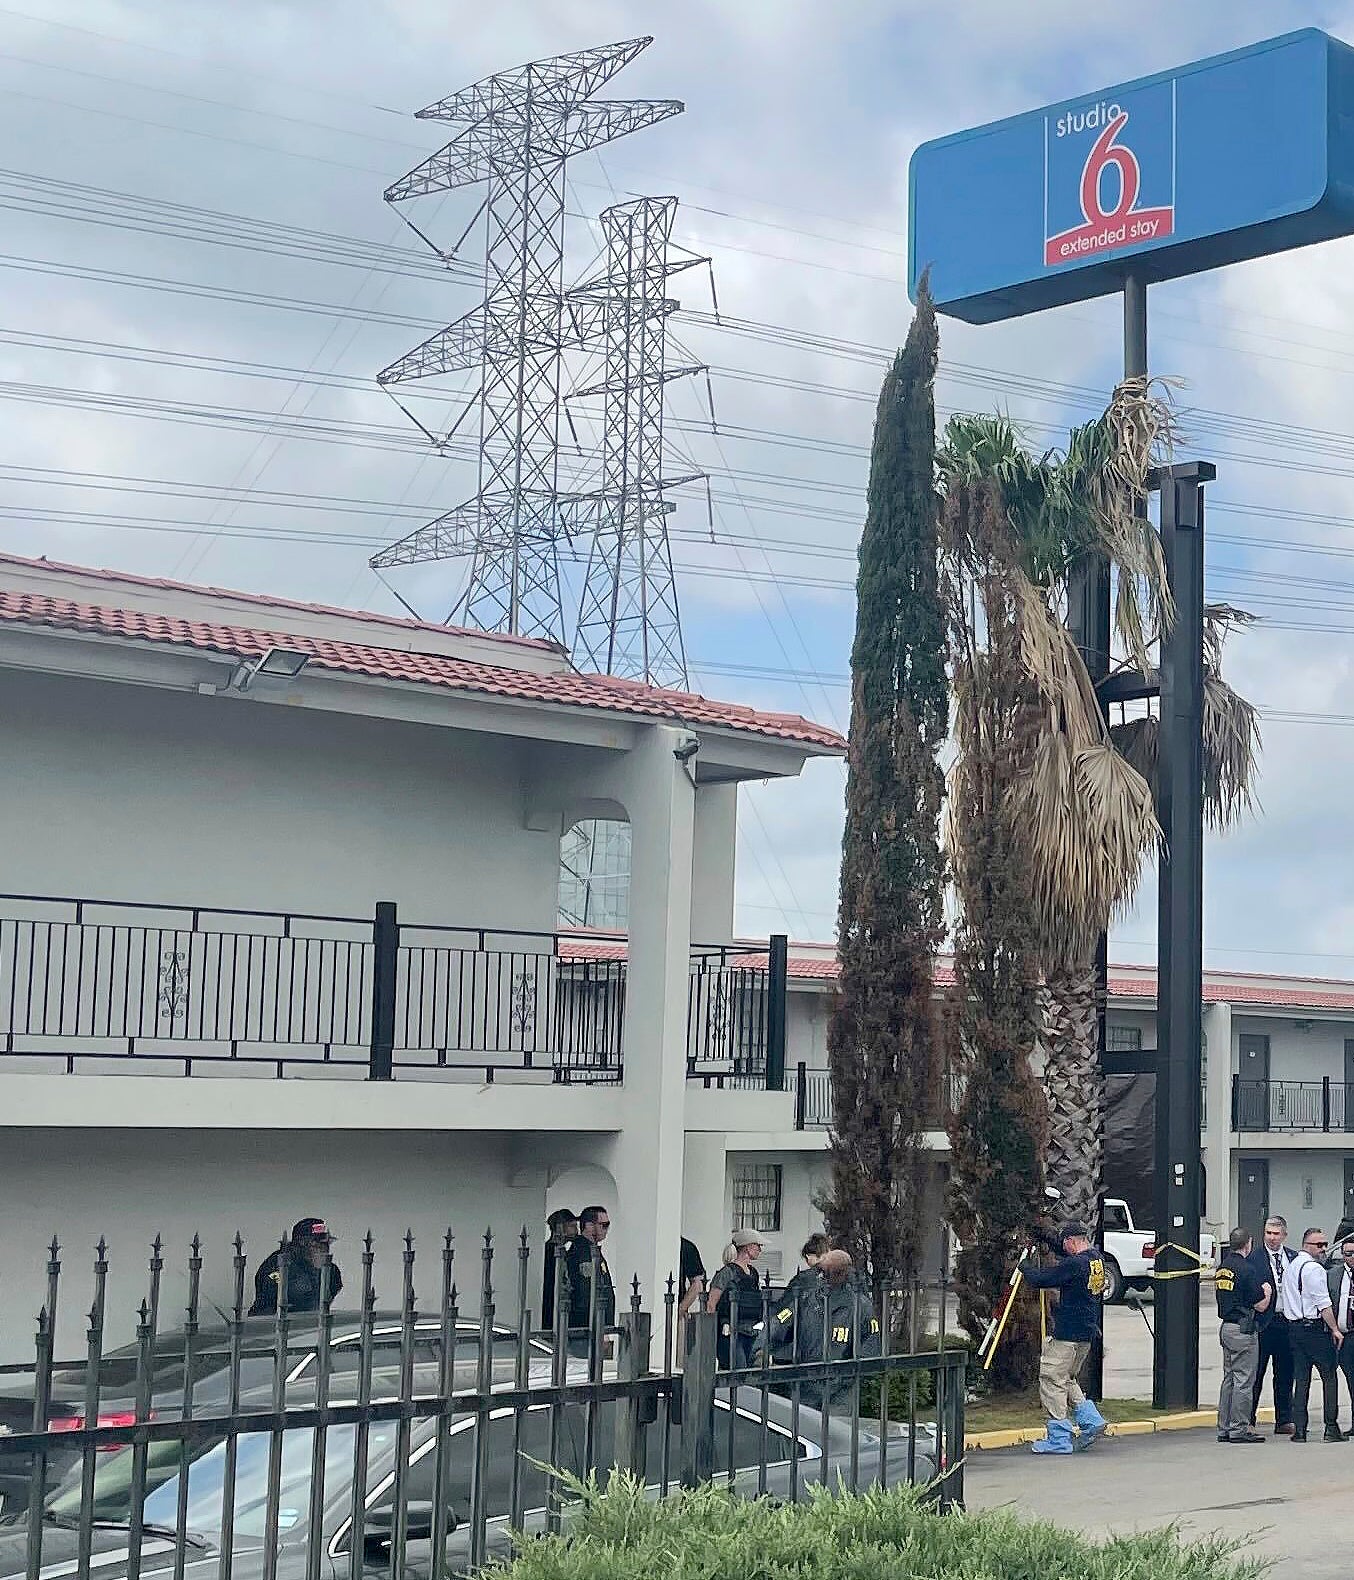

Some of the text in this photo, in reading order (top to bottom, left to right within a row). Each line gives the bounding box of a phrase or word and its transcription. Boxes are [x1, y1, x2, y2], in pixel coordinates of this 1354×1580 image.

[1056, 102, 1121, 138] studio
[1080, 111, 1141, 222] 6
[1060, 219, 1160, 256] extended stay
